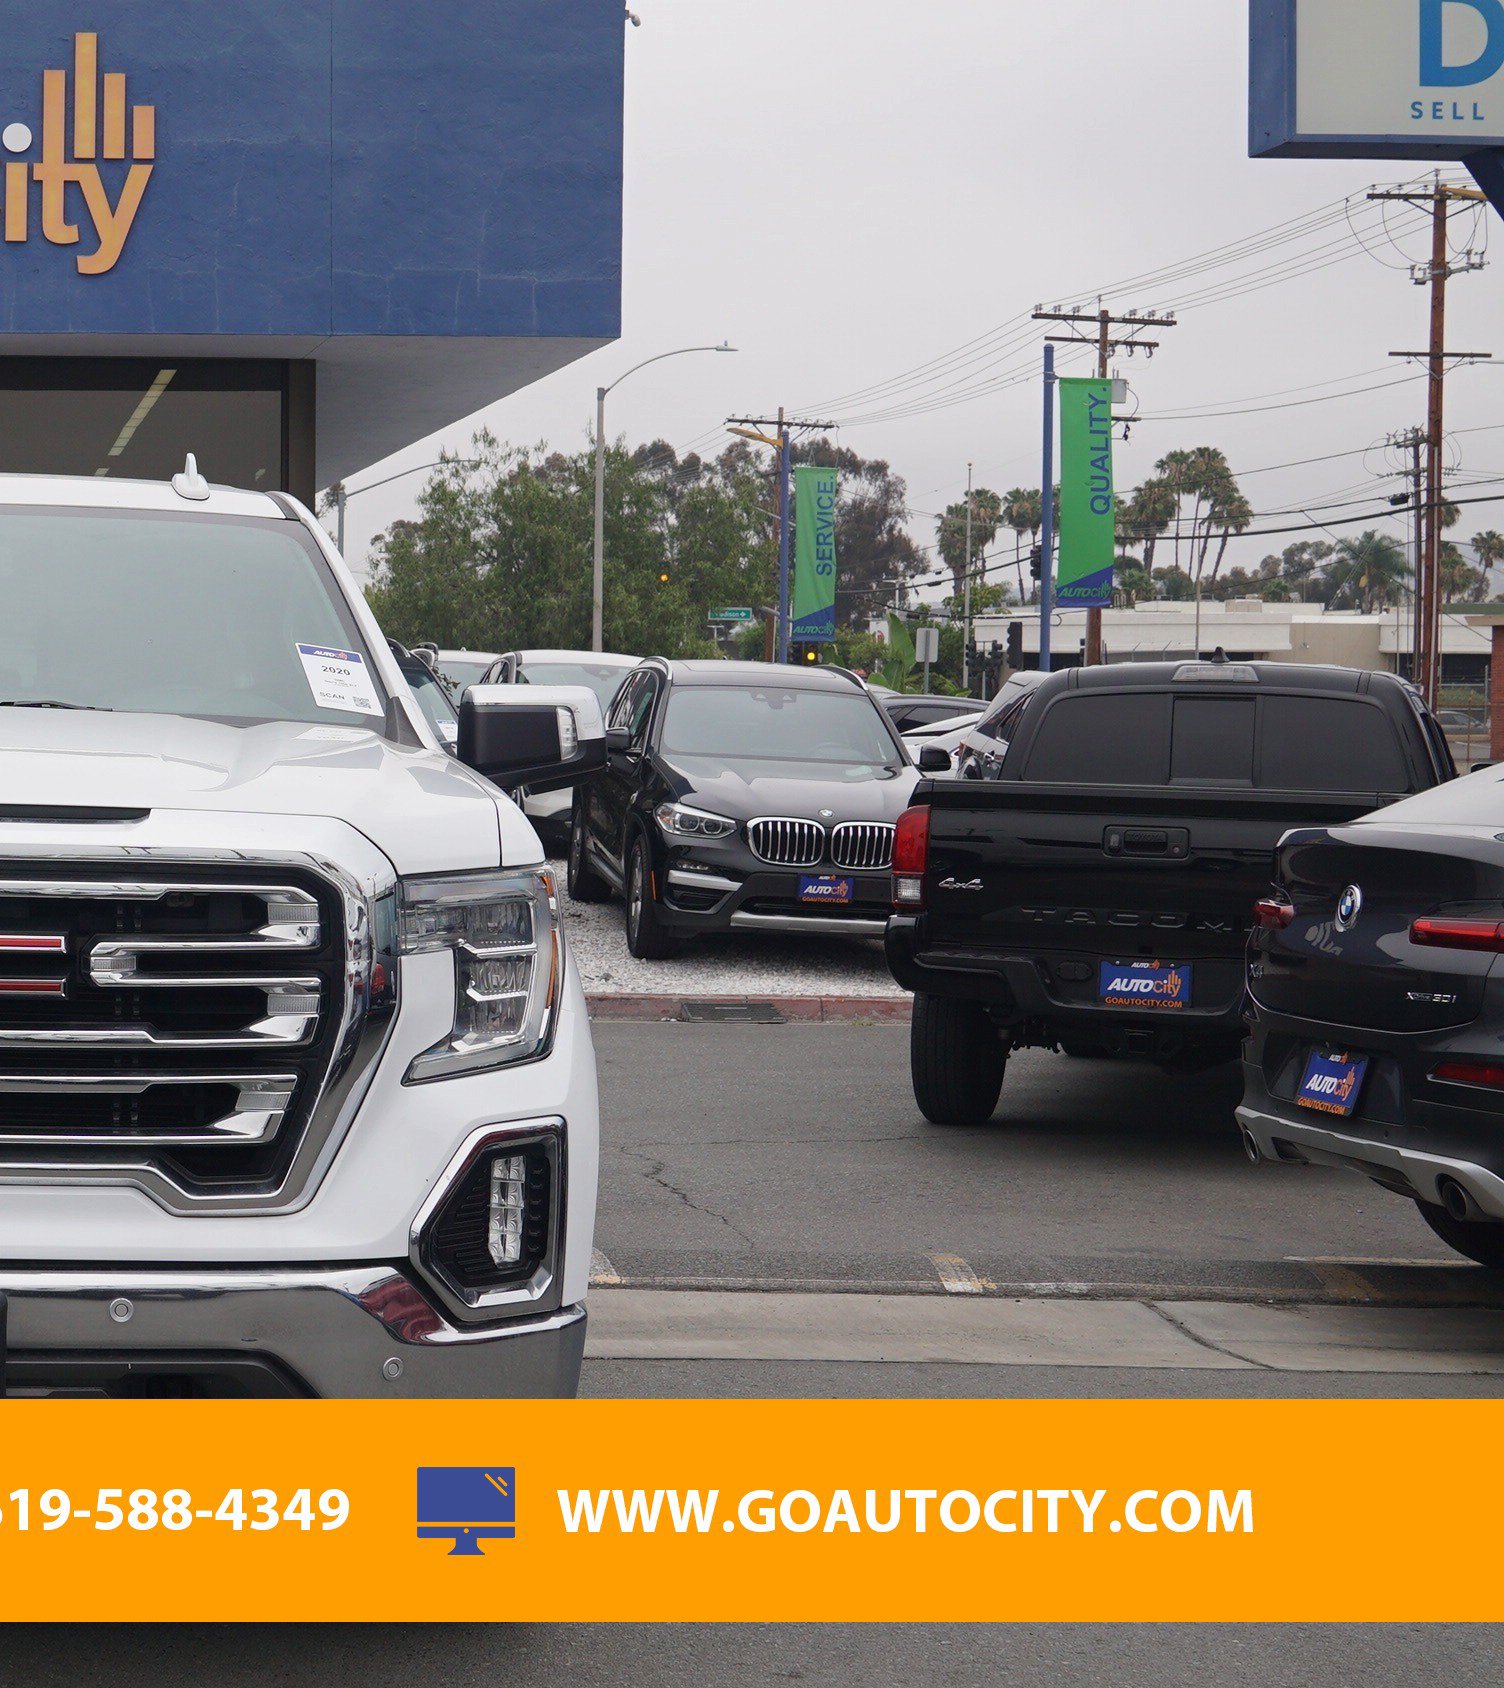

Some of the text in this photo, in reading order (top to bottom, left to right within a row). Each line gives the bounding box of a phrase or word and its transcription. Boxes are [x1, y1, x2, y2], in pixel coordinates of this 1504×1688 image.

[1410, 101, 1484, 120] SELL
[1088, 387, 1111, 515] QUALITY.
[816, 476, 834, 576] SERVICE.
[321, 665, 351, 676] 2020
[938, 877, 984, 890] 4x4
[1105, 996, 1183, 1008] GOAUTOCITY.COM
